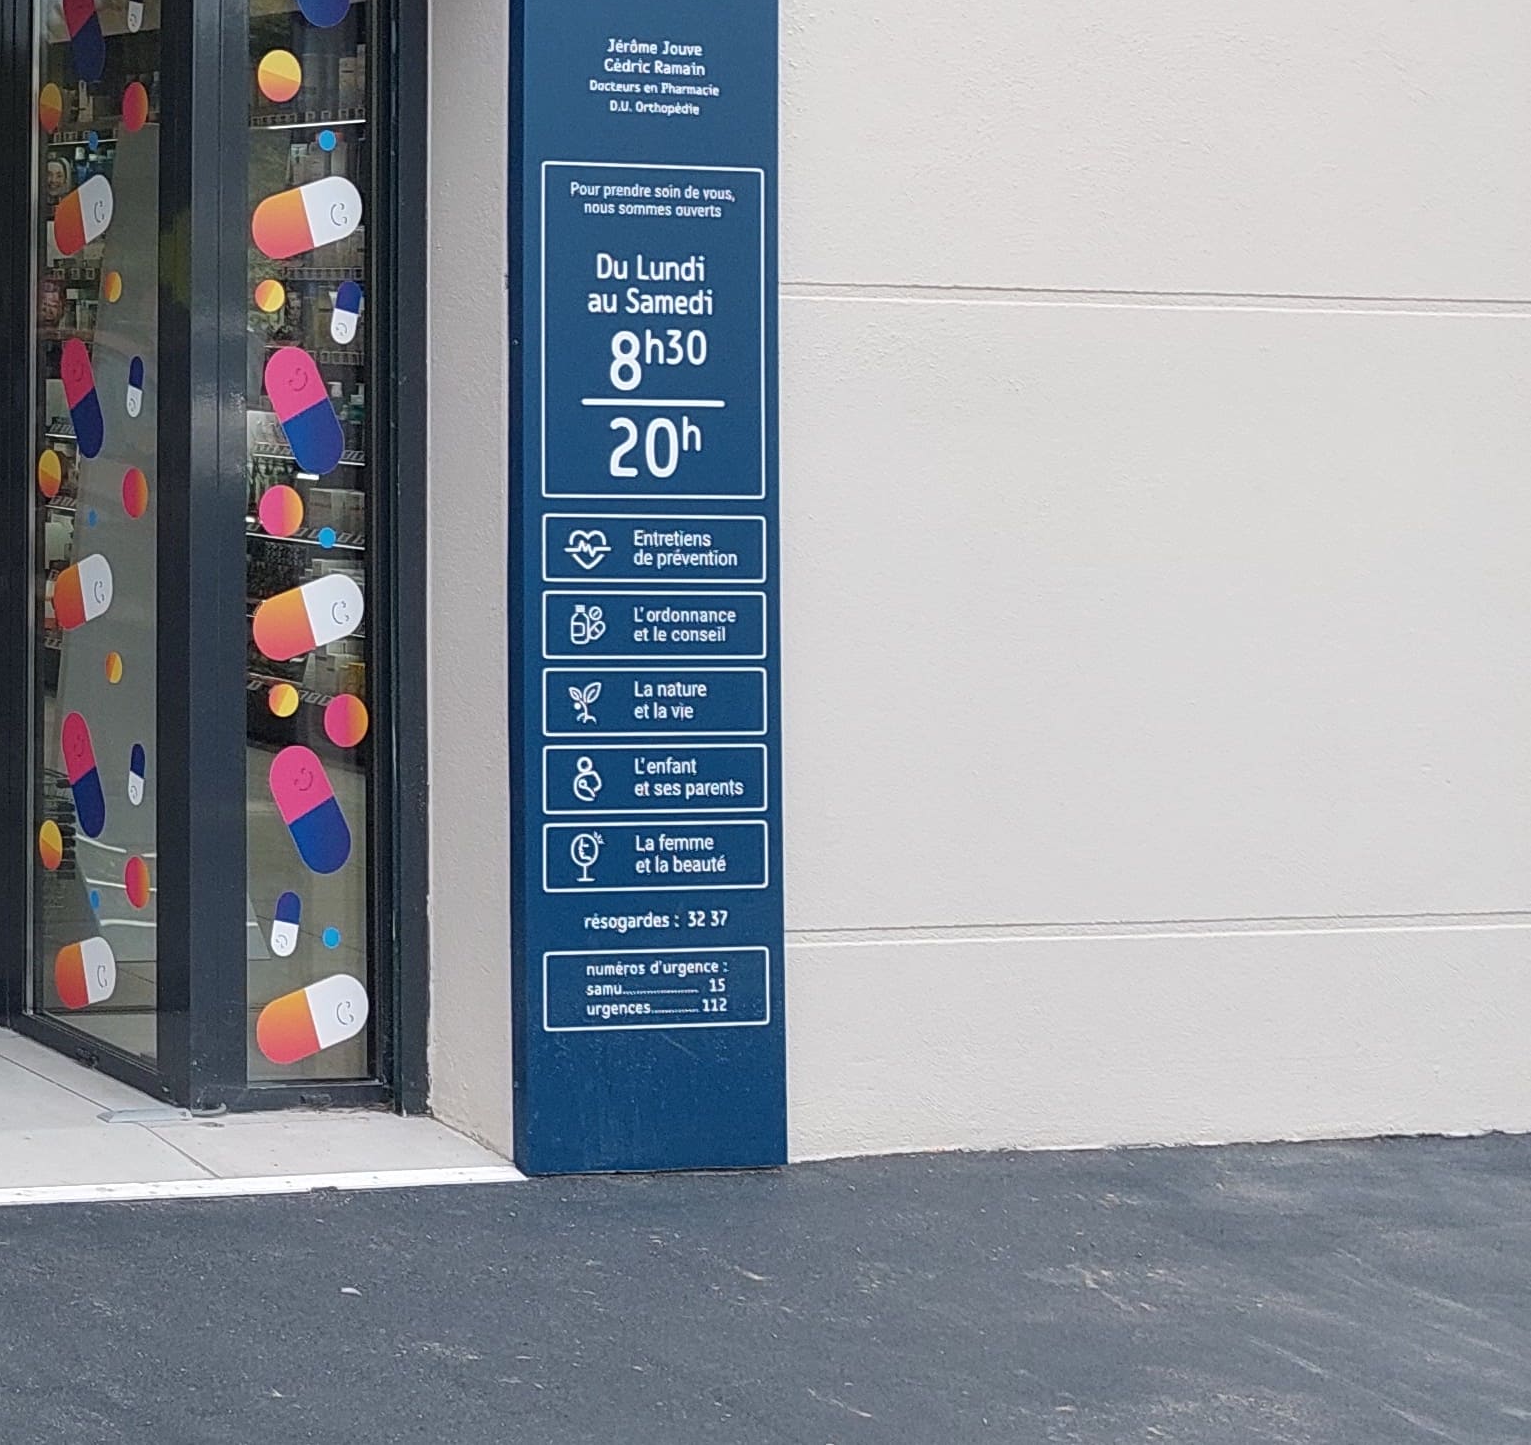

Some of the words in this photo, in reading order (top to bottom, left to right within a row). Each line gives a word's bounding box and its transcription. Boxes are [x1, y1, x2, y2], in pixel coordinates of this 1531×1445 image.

[607, 38, 658, 55] Jérôme
[662, 40, 703, 57] Jouve
[604, 57, 651, 74] Cédric
[654, 60, 706, 76] Ramain
[589, 79, 641, 94] Docteurs
[643, 83, 658, 94] en
[661, 82, 720, 97] Pharmacie
[635, 101, 700, 116] Orthopédie
[570, 181, 602, 197] Pour
[603, 183, 652, 200] prendre
[654, 183, 682, 199] soin
[684, 184, 700, 200] de
[702, 186, 736, 203] vous,
[584, 202, 615, 215] nous
[618, 203, 672, 217] sommes
[675, 204, 723, 218] ouverts
[596, 252, 628, 280] Du
[637, 253, 706, 282] Lundi
[588, 292, 618, 314] au
[625, 287, 714, 316] Samedi
[609, 329, 708, 391] 8h30
[609, 415, 702, 479] 20h
[633, 529, 712, 547] Entretiens
[633, 550, 654, 567] de
[657, 549, 738, 570] prévention
[634, 627, 650, 642] et
[653, 626, 668, 642] le
[671, 625, 726, 642] conseil
[634, 680, 653, 697] La
[657, 682, 708, 698] nature
[634, 704, 650, 719] et
[653, 702, 669, 720] la
[671, 703, 694, 720] vie
[634, 756, 697, 775] L'enfant
[634, 781, 650, 797] et
[653, 781, 682, 797] ses
[685, 779, 744, 800] parents
[635, 834, 656, 852] La
[658, 833, 714, 852] femme
[635, 857, 652, 874] et
[654, 856, 670, 874] la
[672, 854, 727, 873] beauté
[584, 910, 670, 934] résogardes
[687, 910, 706, 927] 32
[710, 909, 728, 927] 37
[586, 960, 646, 977] numéros
[650, 958, 720, 978] d'urgence
[708, 978, 726, 992] 15
[702, 997, 727, 1013] 112
